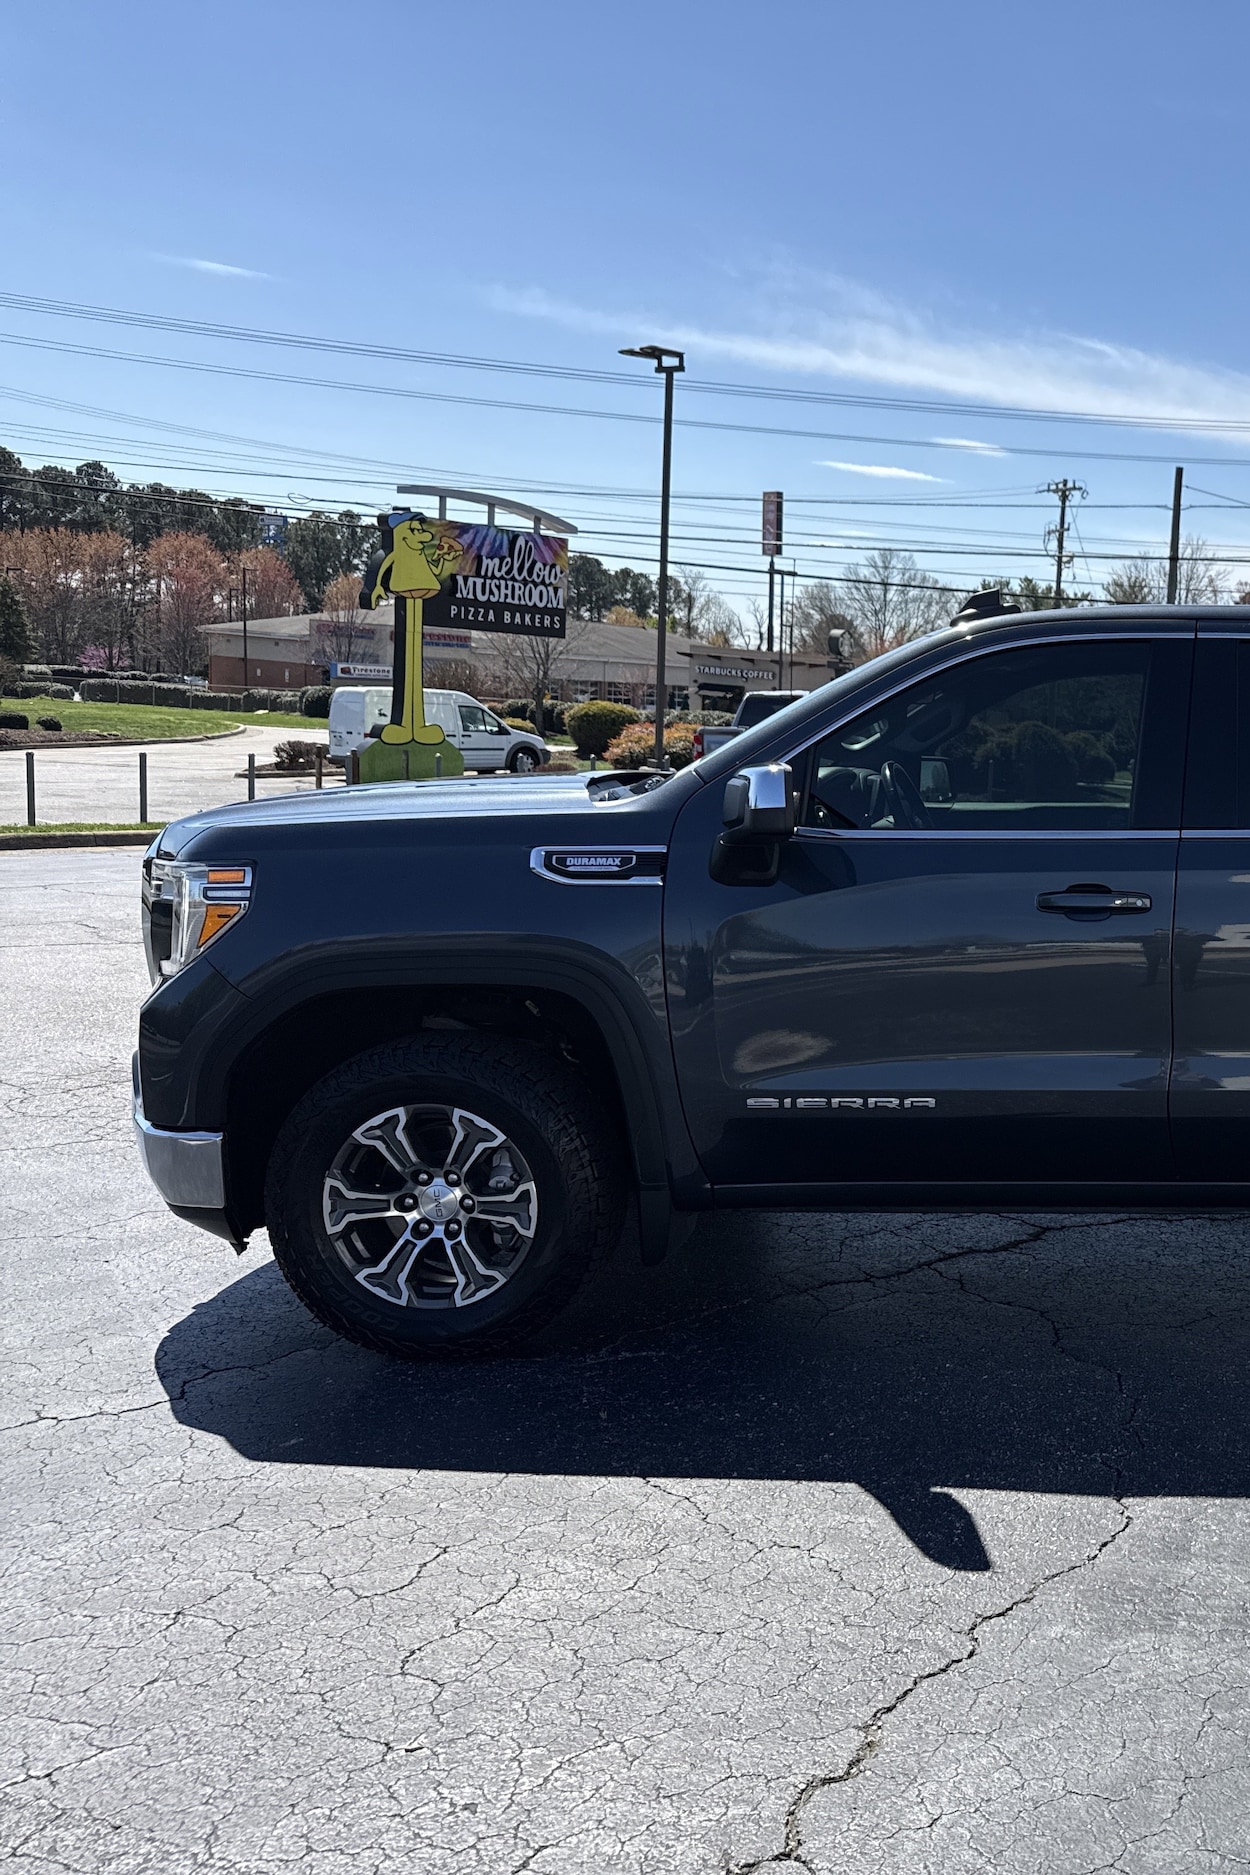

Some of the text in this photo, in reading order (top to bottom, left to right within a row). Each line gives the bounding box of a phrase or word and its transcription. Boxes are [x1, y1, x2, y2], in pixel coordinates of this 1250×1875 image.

[481, 535, 566, 584] mellow
[455, 575, 565, 609] MUSHROOM
[450, 605, 561, 629] PIZZA BAKERS
[695, 666, 774, 680] STARBUCKS COFFEE
[566, 857, 621, 866] DURAMAX
[746, 1097, 936, 1110] SIERRA
[433, 1188, 443, 1218] GMC
